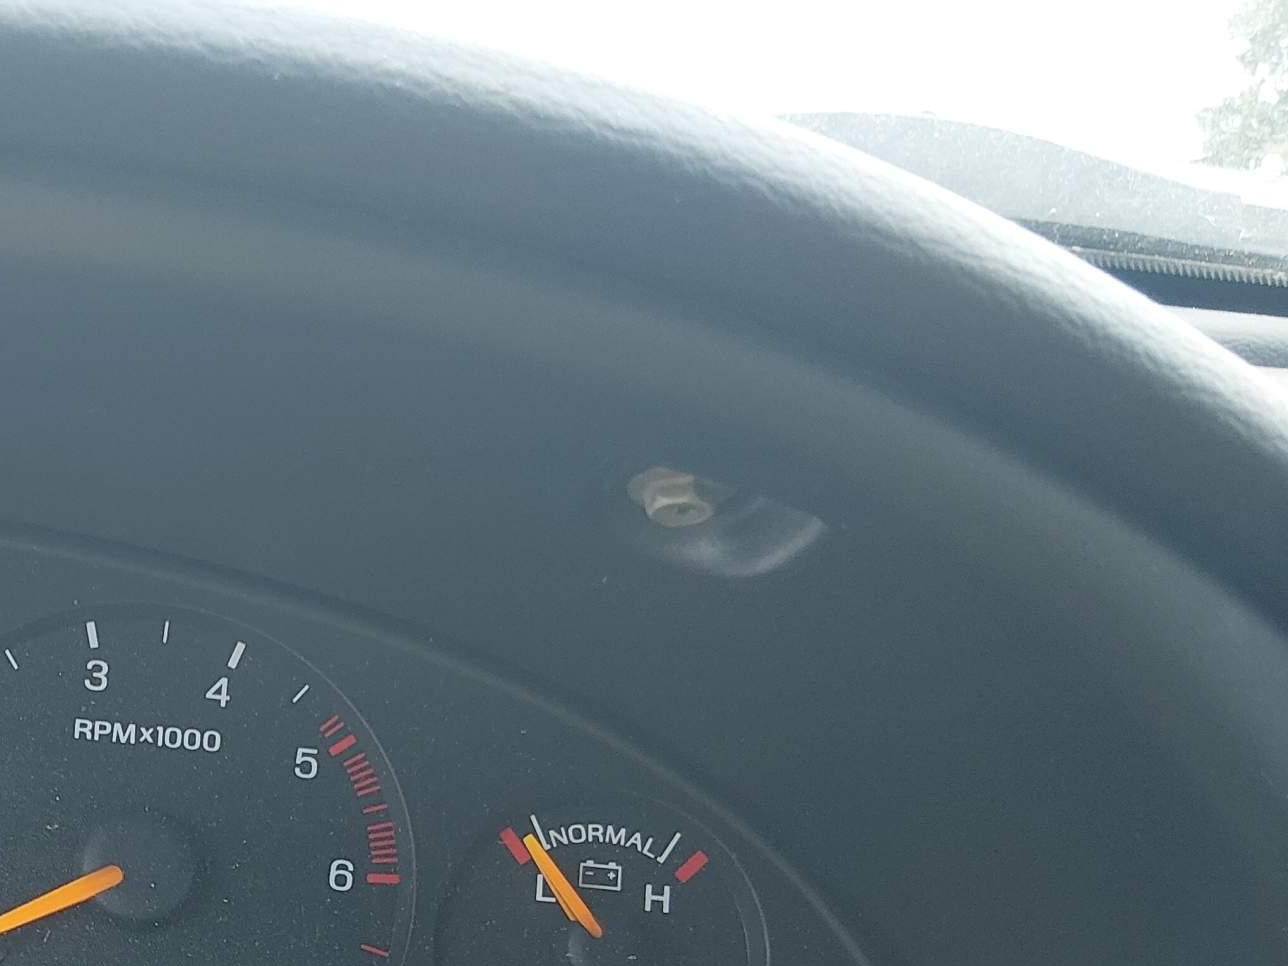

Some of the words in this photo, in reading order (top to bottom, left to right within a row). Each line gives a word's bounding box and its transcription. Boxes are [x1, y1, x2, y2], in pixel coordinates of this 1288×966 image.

[85, 660, 109, 691] 3
[205, 677, 230, 708] 4
[294, 748, 318, 779] 5
[549, 824, 655, 859] NORMAL
[329, 859, 354, 891] 6
[536, 874, 558, 902] L
[644, 884, 670, 913] H
